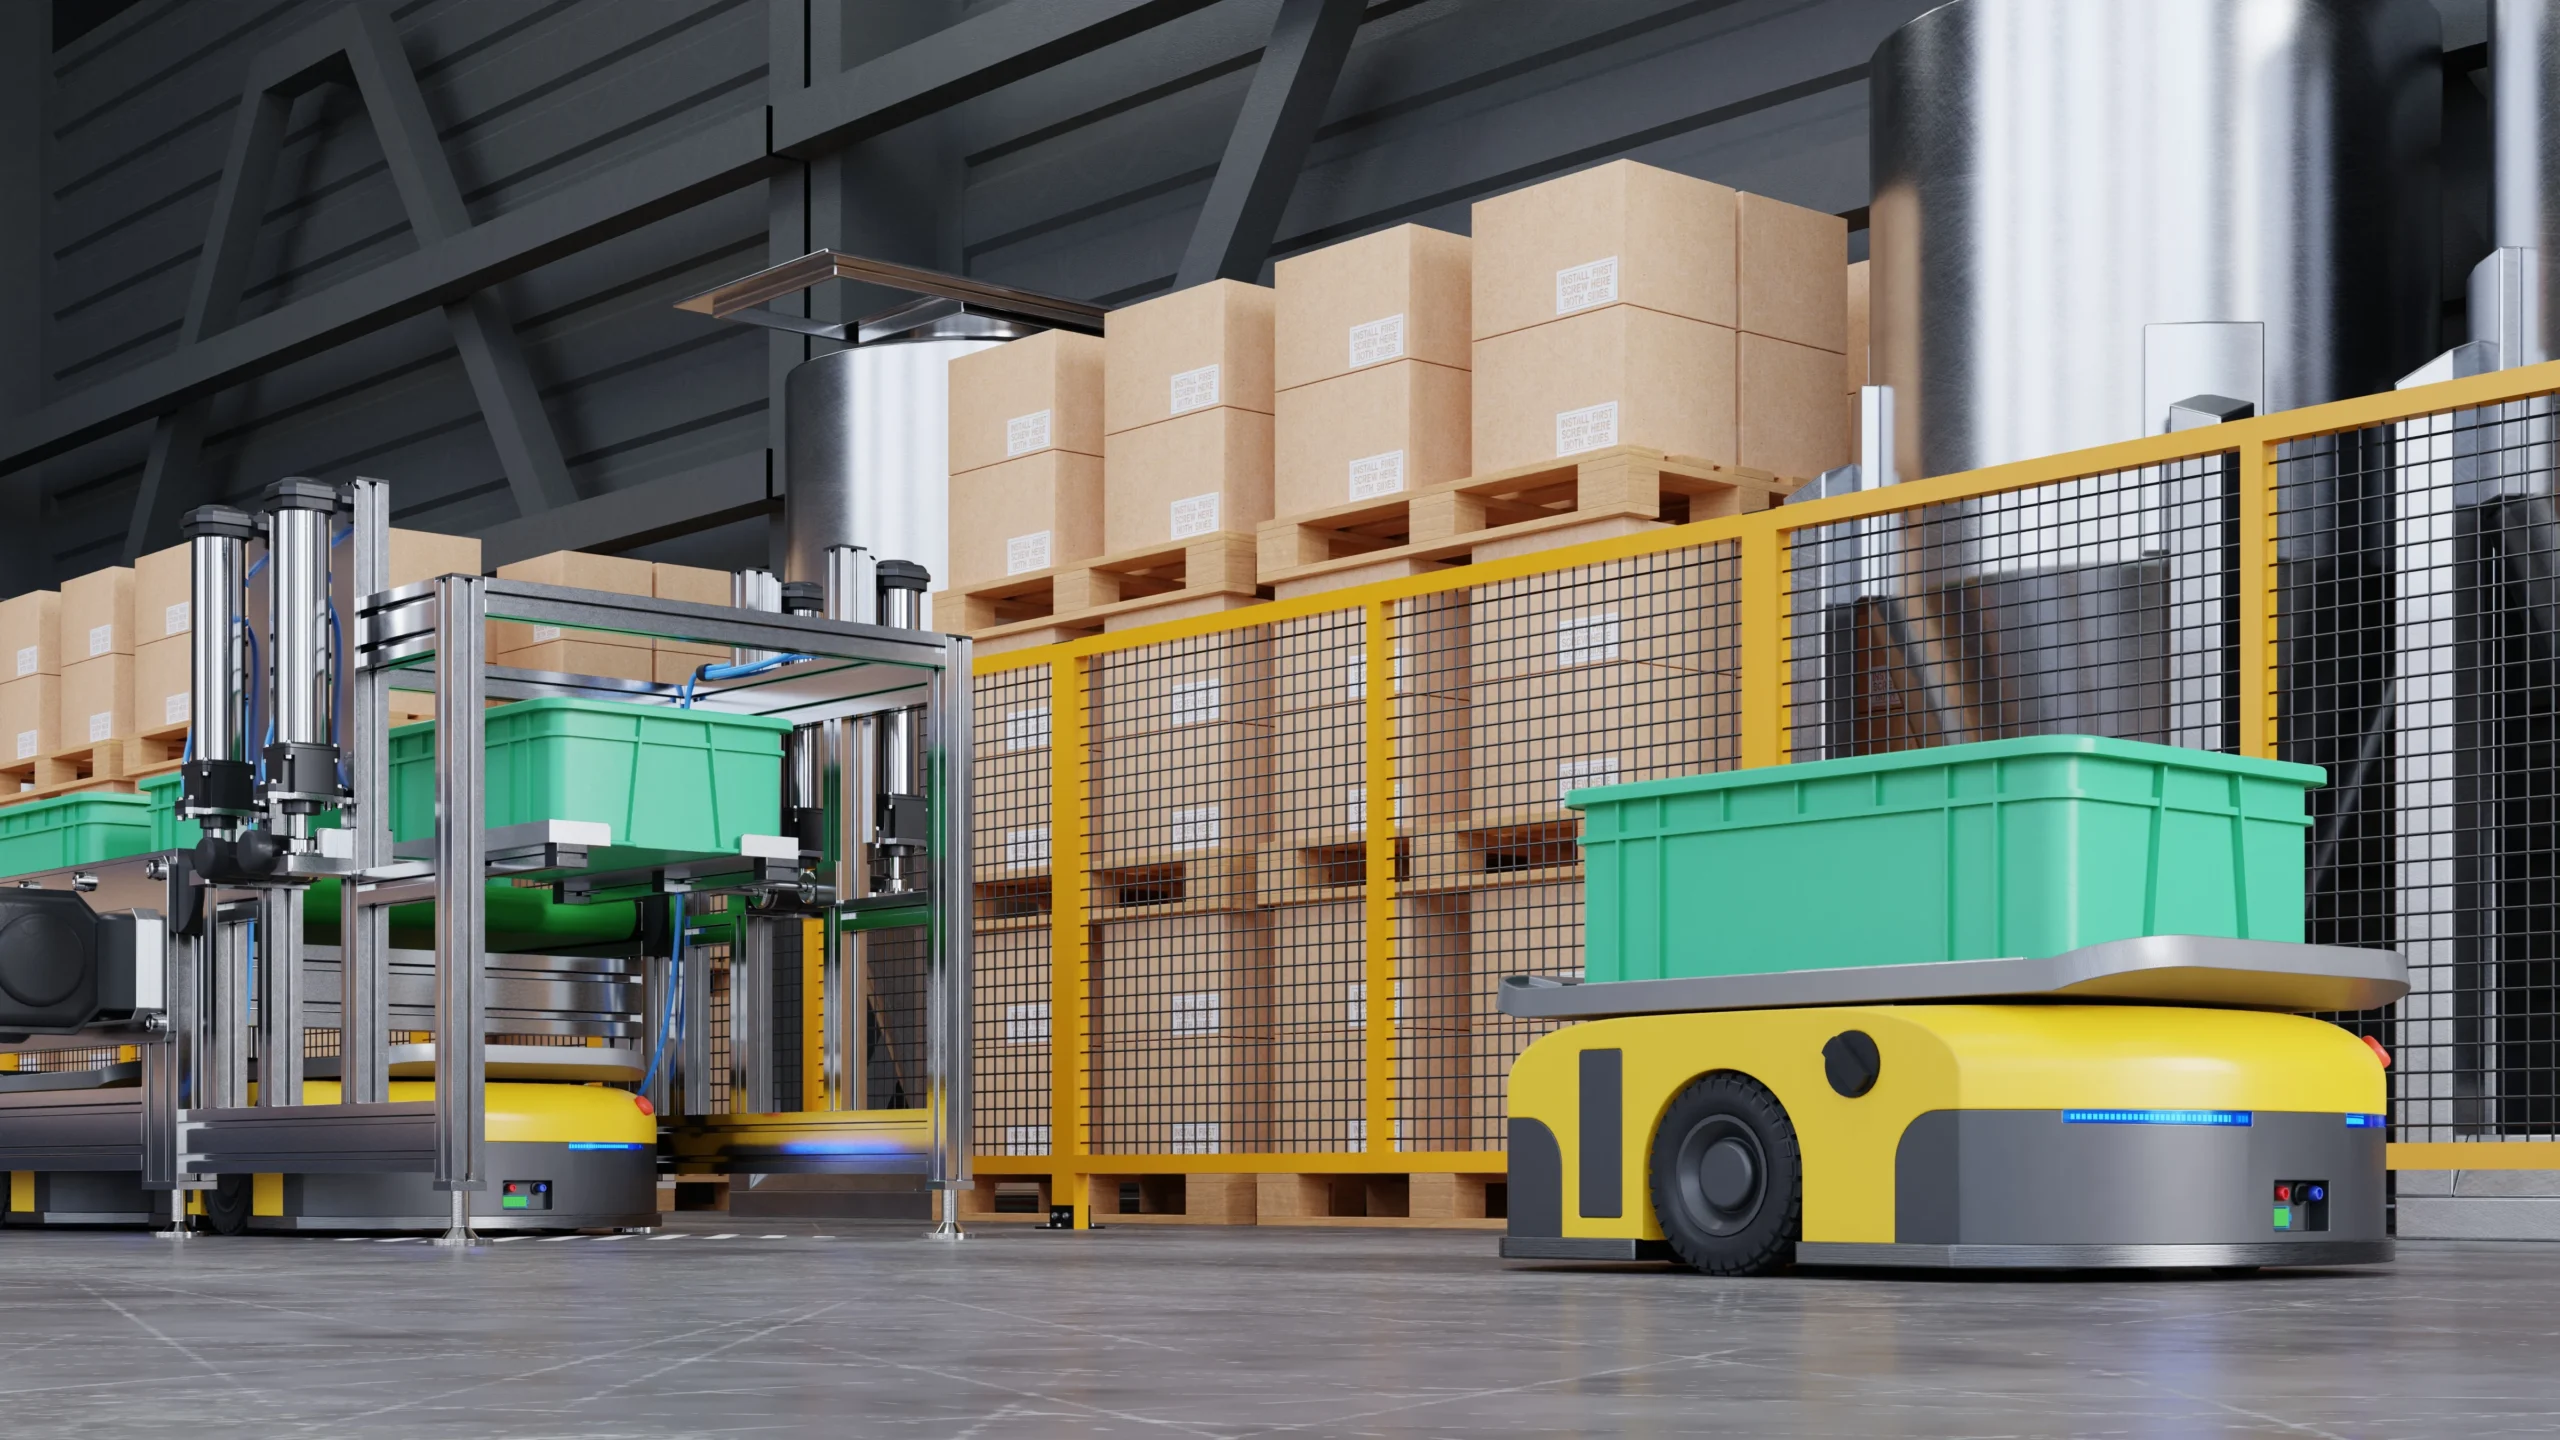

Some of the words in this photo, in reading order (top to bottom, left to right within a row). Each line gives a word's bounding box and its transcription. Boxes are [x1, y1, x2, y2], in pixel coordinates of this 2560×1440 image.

[1561, 270, 1590, 286] INSTALL
[1592, 264, 1613, 278] FIRST
[1562, 281, 1589, 297] SCREW
[1591, 276, 1611, 289] HERE
[1564, 294, 1584, 308] BOTH
[1588, 288, 1609, 302] SIDES
[1353, 326, 1378, 341] INSTALL
[1380, 321, 1398, 334] FIRST
[1354, 337, 1378, 351] SCREW
[1379, 332, 1397, 344] HERE
[1356, 349, 1373, 362] BOTH
[1376, 343, 1395, 356] SIDES
[1175, 375, 1198, 389] INSTALL
[1200, 371, 1216, 383] FIRST
[1176, 385, 1198, 398] SCREW
[1198, 381, 1215, 392] HERE
[1561, 413, 1590, 429] INSTALL
[1592, 408, 1613, 422] FIRST
[1562, 425, 1589, 439] SCREW
[1591, 420, 1611, 433] HERE
[1564, 437, 1584, 450] BOTH
[1588, 432, 1609, 445] SIDES
[1353, 461, 1378, 475] INSTALL
[1380, 457, 1399, 469] FIRST
[1354, 472, 1378, 485] SCREW
[1379, 468, 1397, 479] HERE
[1356, 483, 1374, 495] BOTH
[1377, 479, 1395, 491] SIDES
[1175, 503, 1198, 515] INSTALL
[1176, 512, 1198, 524] SCREW
[1199, 509, 1215, 519] HERE
